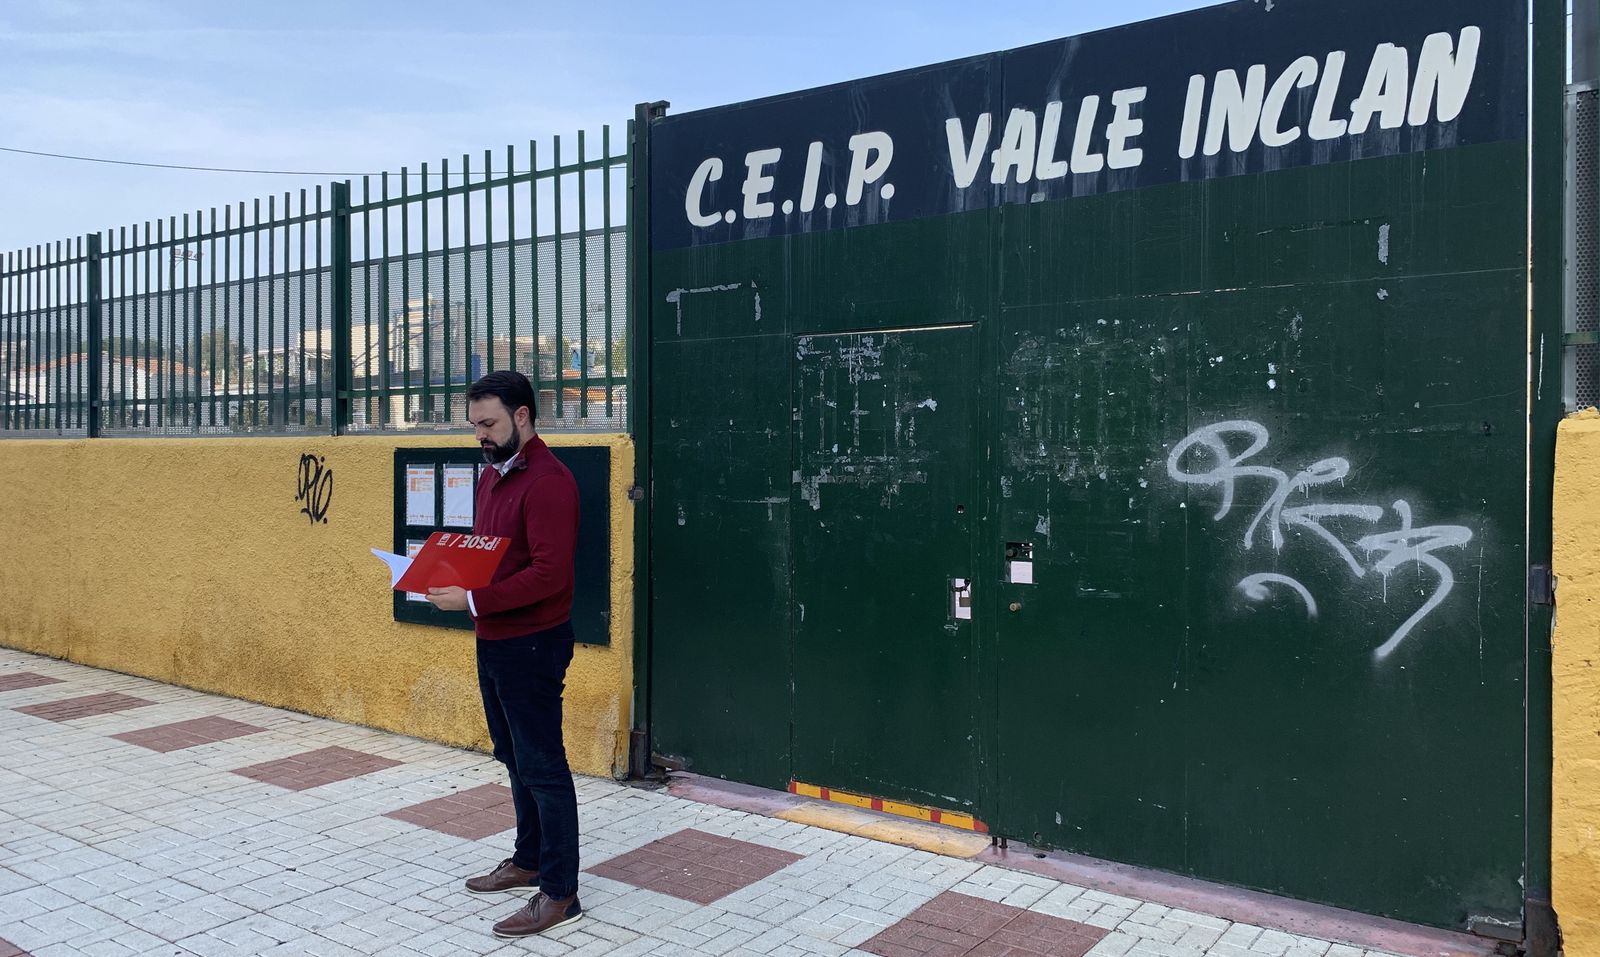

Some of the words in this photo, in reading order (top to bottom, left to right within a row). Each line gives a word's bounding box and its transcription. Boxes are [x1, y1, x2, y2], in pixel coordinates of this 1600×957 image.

[685, 131, 895, 227] C.E.I.P.
[945, 86, 1146, 188] VALLE
[1178, 26, 1480, 158] INCLAN
